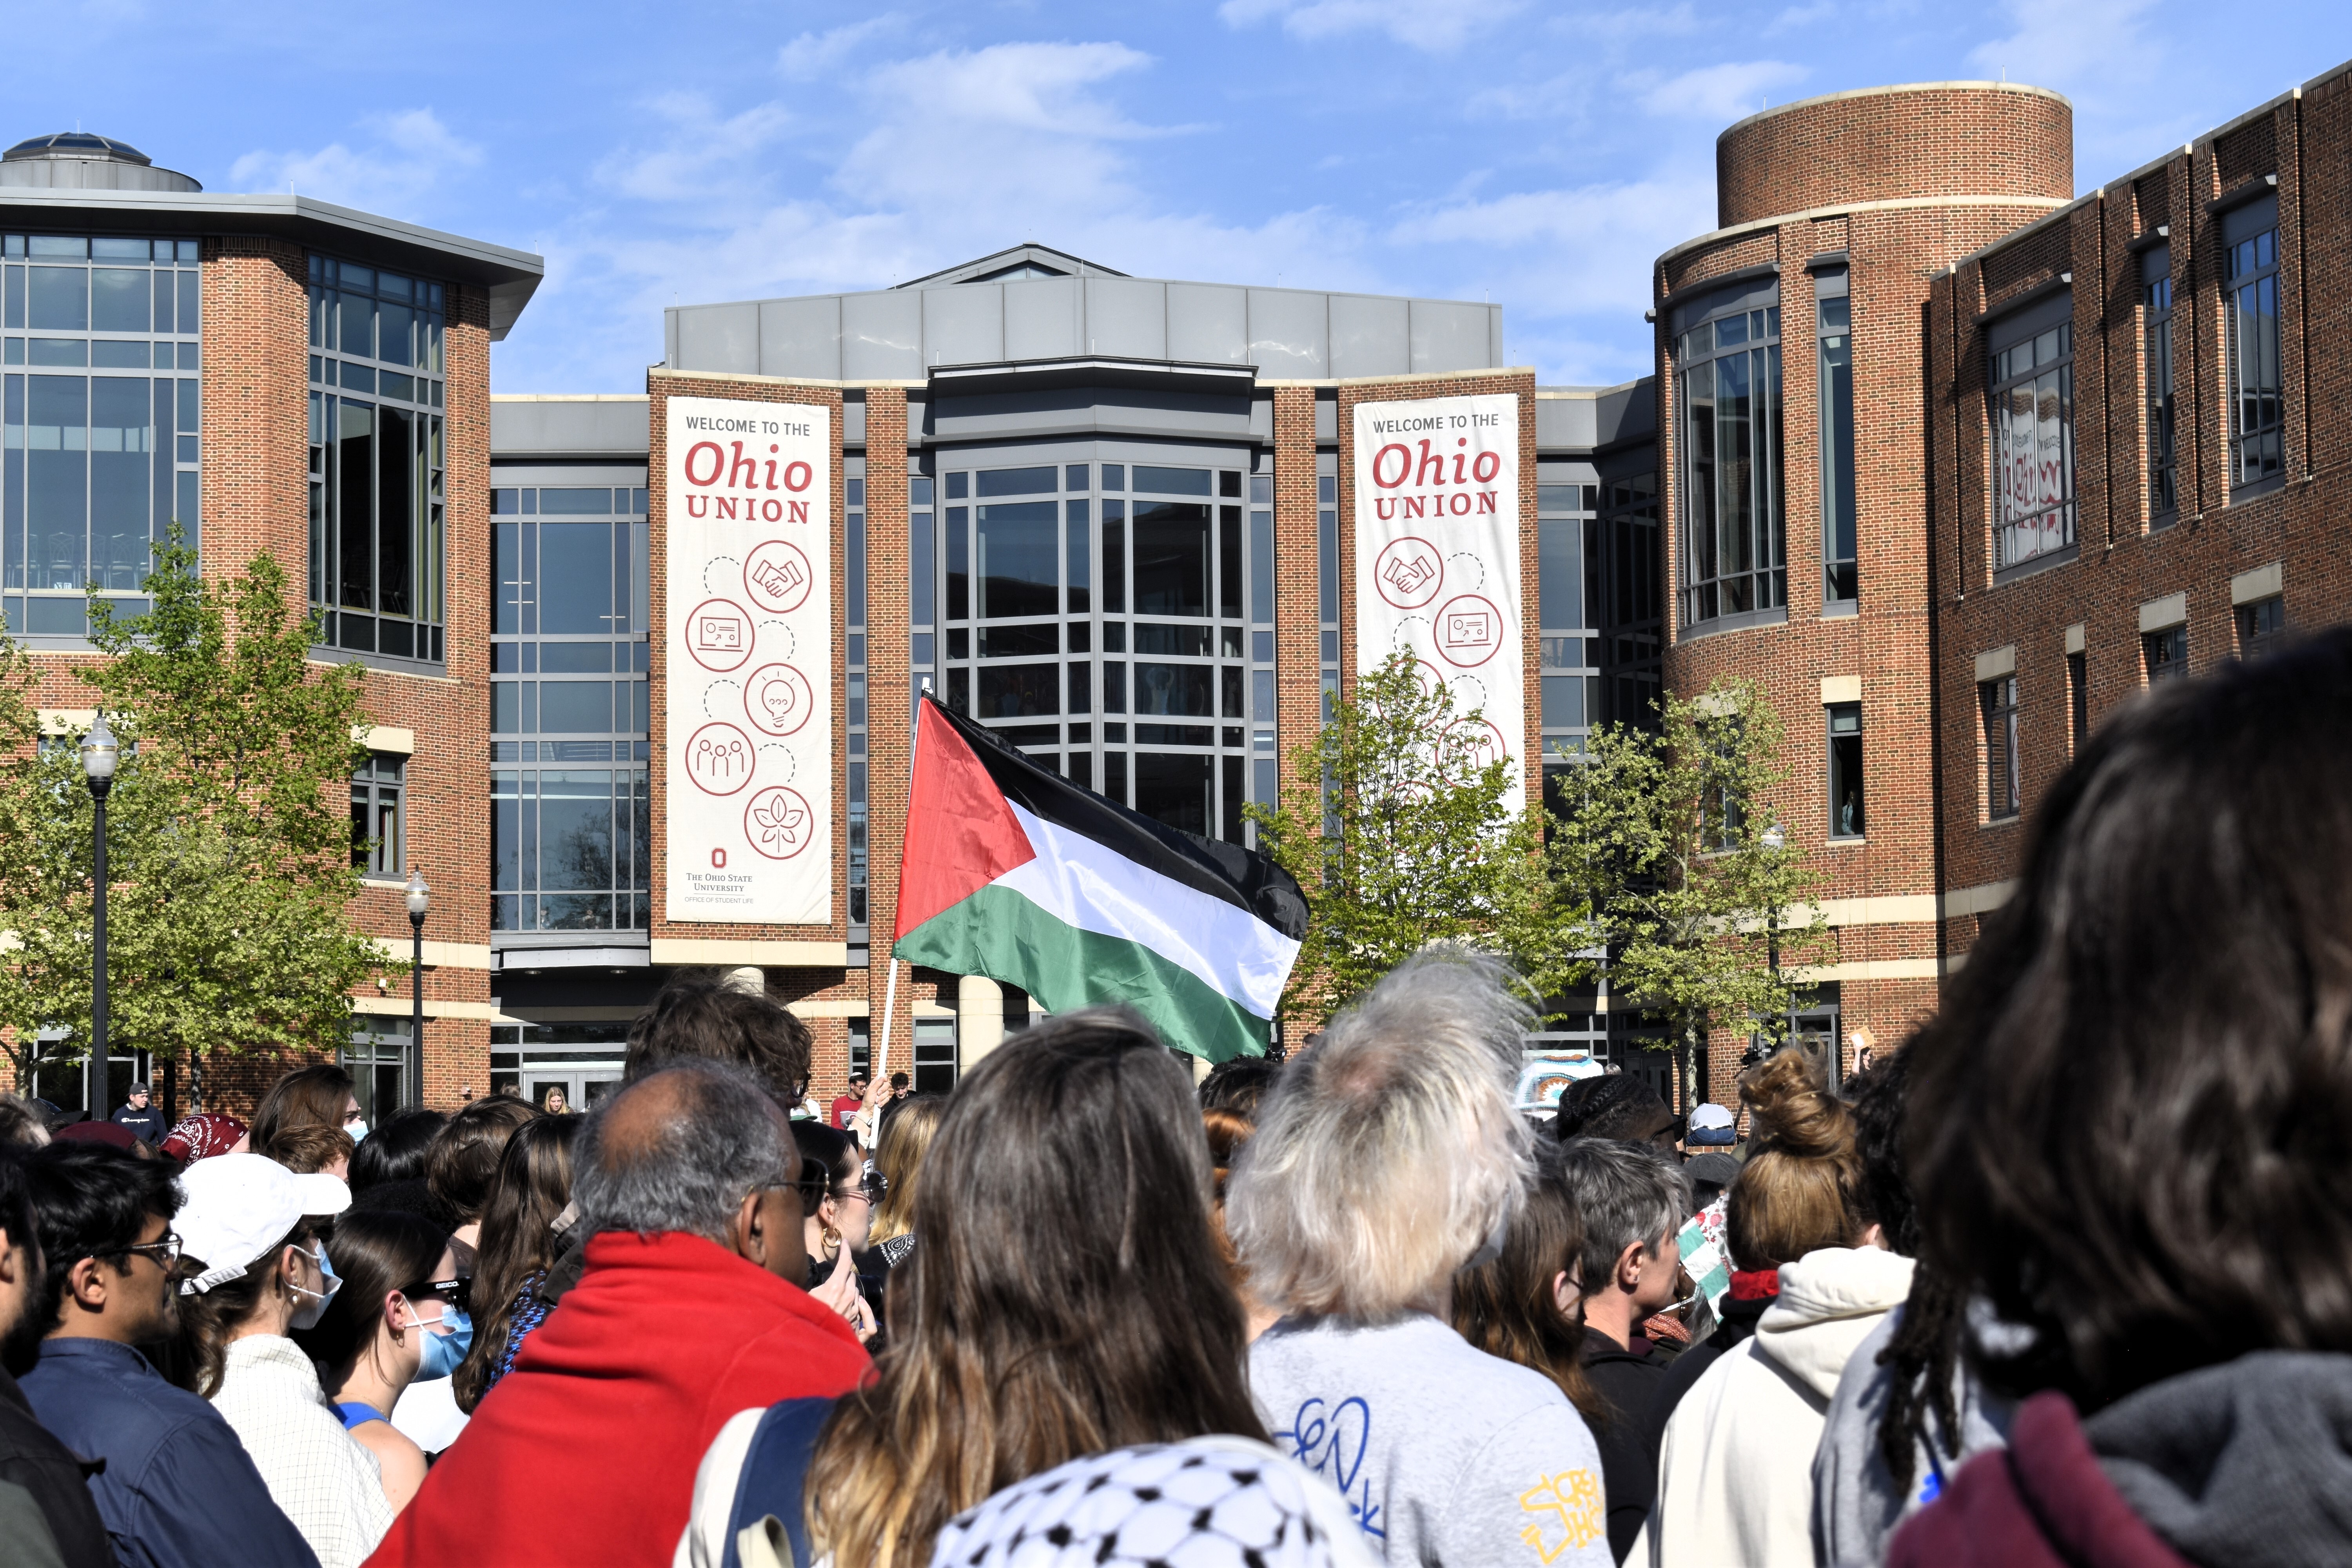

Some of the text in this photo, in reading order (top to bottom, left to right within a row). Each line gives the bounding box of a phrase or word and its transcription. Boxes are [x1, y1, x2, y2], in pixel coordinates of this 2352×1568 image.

[686, 416, 810, 436] WELCOME TO THE
[1373, 414, 1498, 433] WELCOME TO THE
[685, 441, 813, 492] Ohio
[1373, 437, 1500, 489] Ohio
[686, 495, 810, 524] UNION
[1374, 491, 1497, 520] UNION
[686, 873, 702, 881] THE
[705, 873, 726, 882] OHIO
[694, 883, 744, 892] UNIVERSITY
